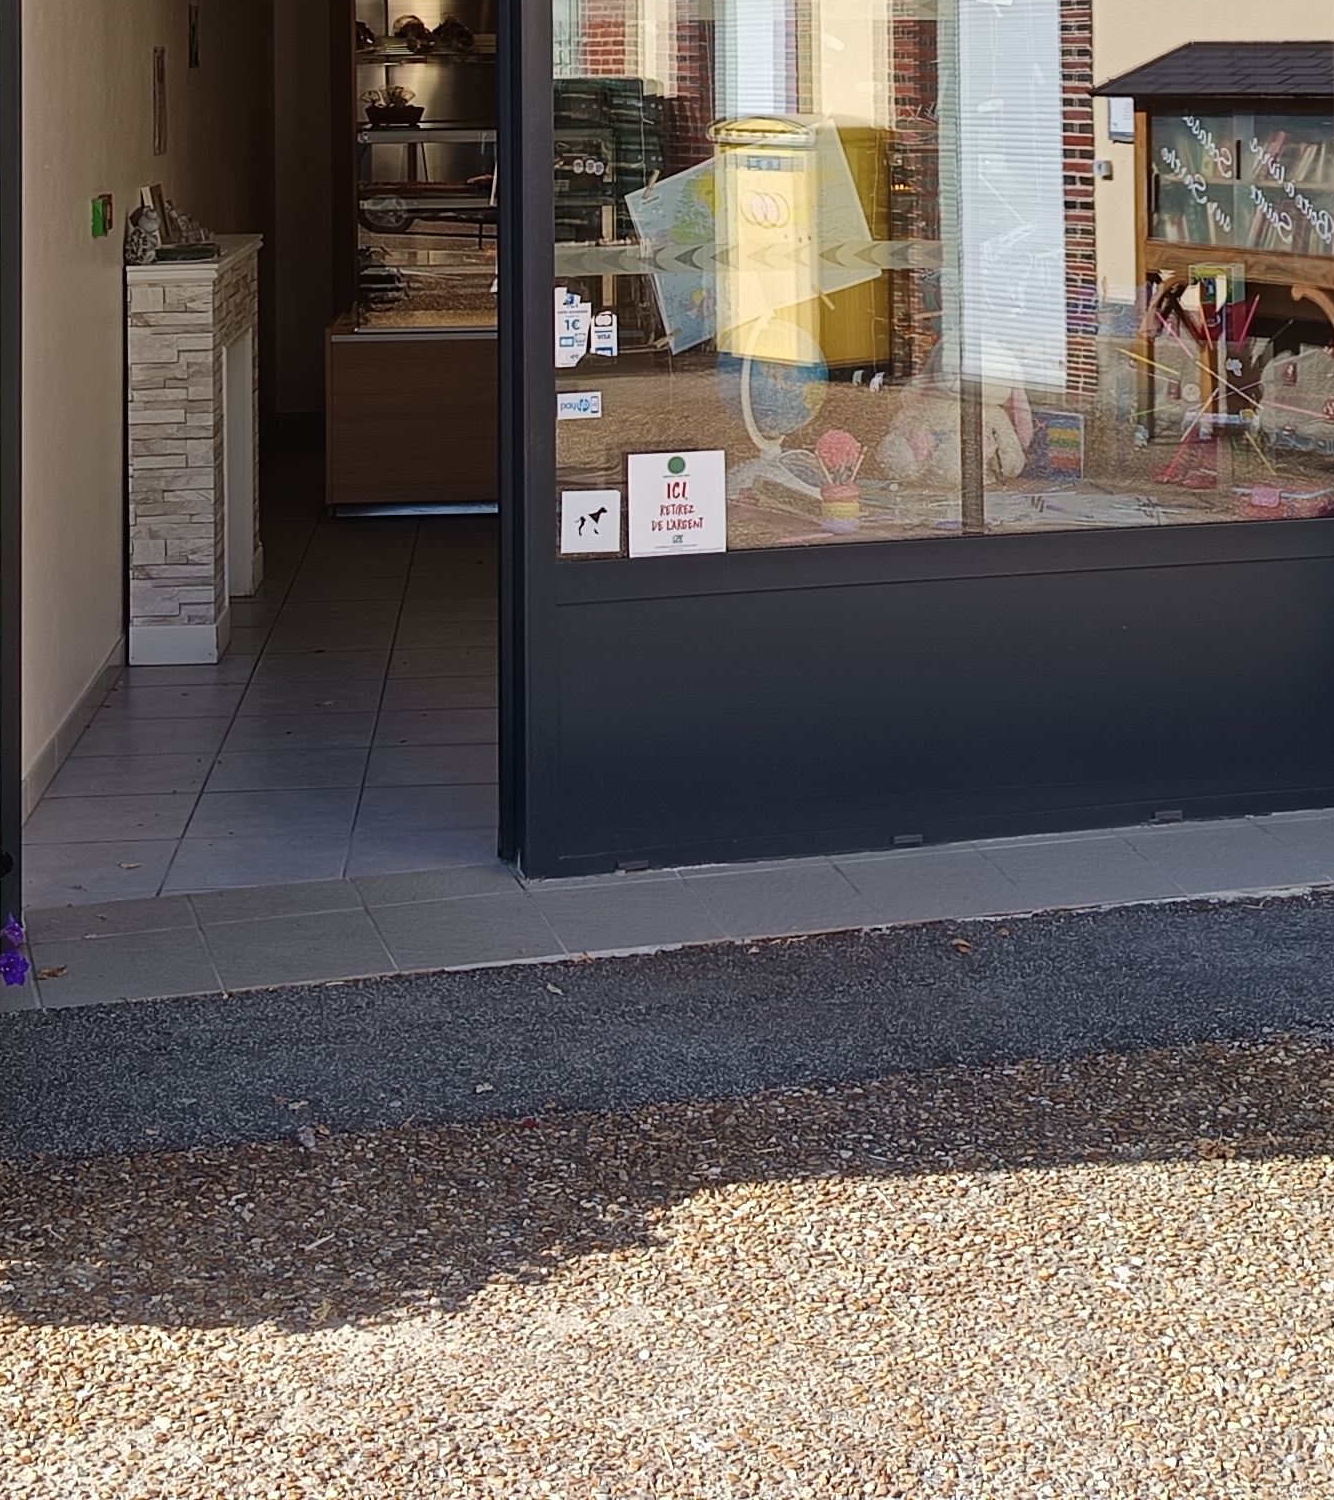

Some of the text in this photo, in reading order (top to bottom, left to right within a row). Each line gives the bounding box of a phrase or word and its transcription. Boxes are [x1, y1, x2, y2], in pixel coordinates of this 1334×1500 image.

[564, 319, 580, 331] 1€
[660, 504, 695, 516] RETIREZ
[651, 517, 703, 531] DE L'ARGENT
